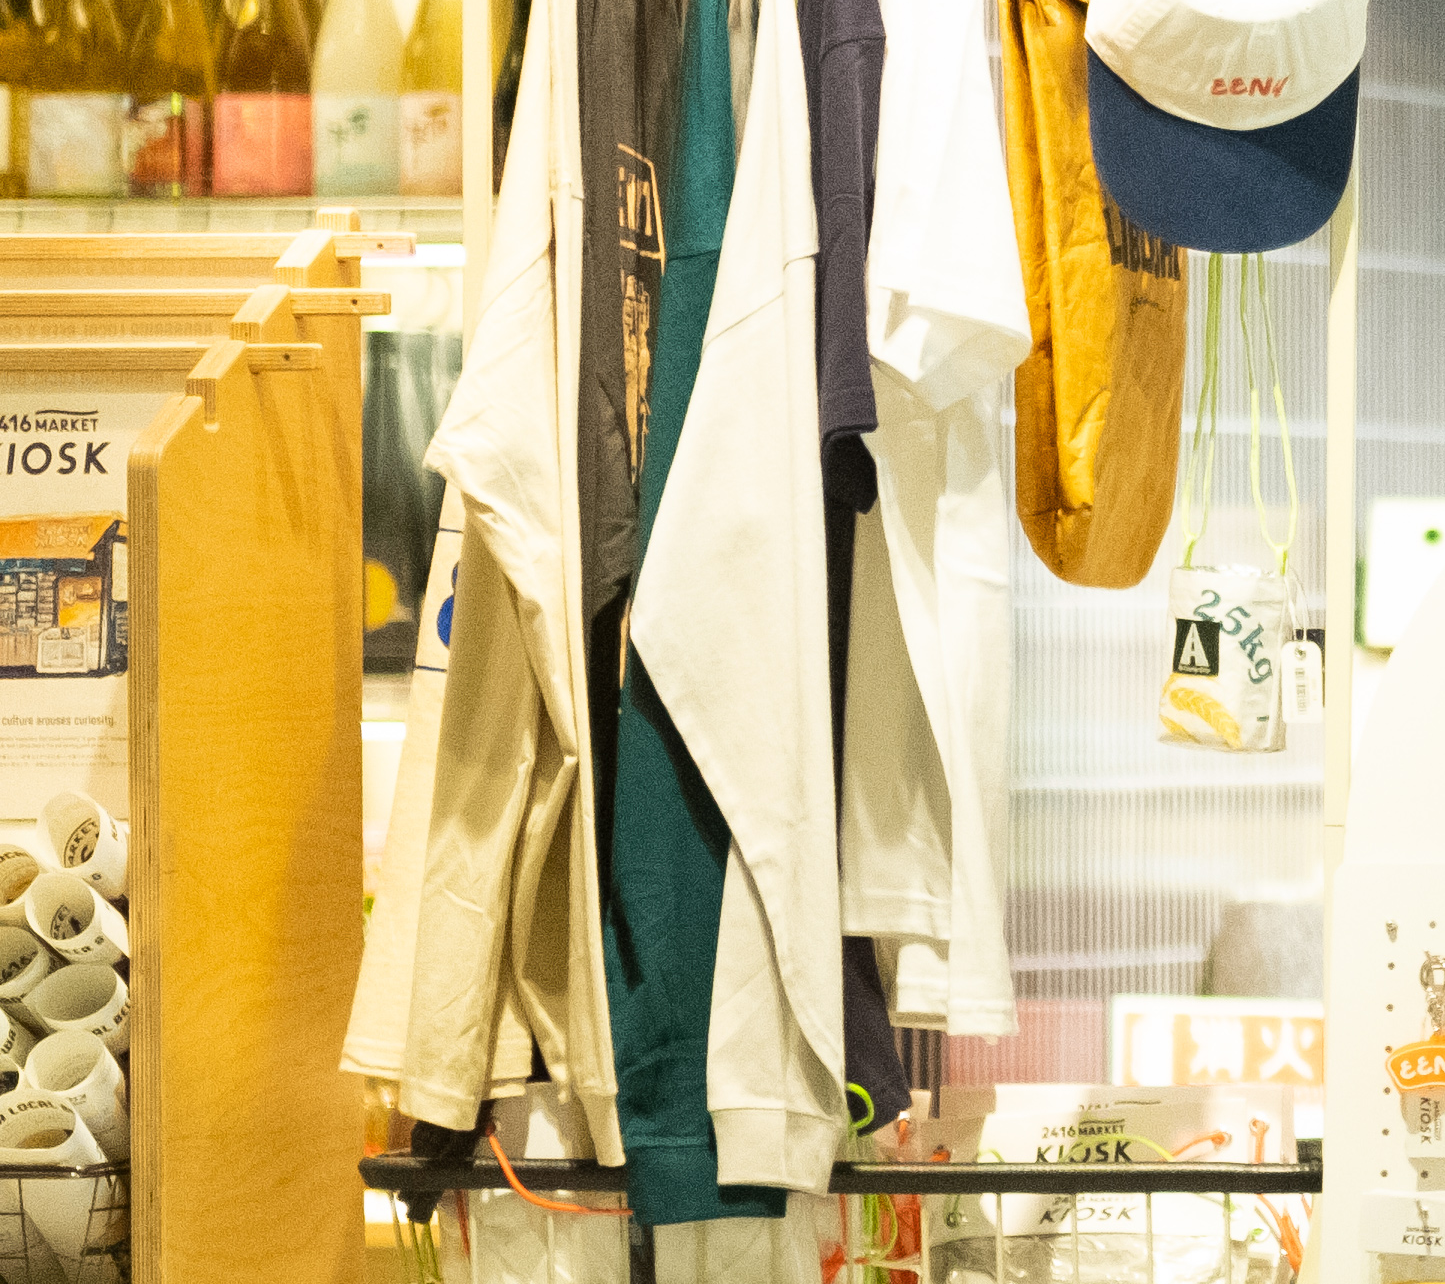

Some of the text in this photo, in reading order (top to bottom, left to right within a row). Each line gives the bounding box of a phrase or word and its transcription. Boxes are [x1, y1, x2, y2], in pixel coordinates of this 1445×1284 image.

[36, 418, 99, 433] MARKET
[0, 441, 110, 475] IOSK
[1192, 588, 1274, 686] 25kg
[1420, 1096, 1433, 1145] KIOSK
[1042, 1124, 1126, 1139] 2416 MARKET
[1036, 1140, 1133, 1164] KIOSK
[1040, 1206, 1140, 1225] KIOSK
[1402, 1234, 1443, 1247] KIOSK
